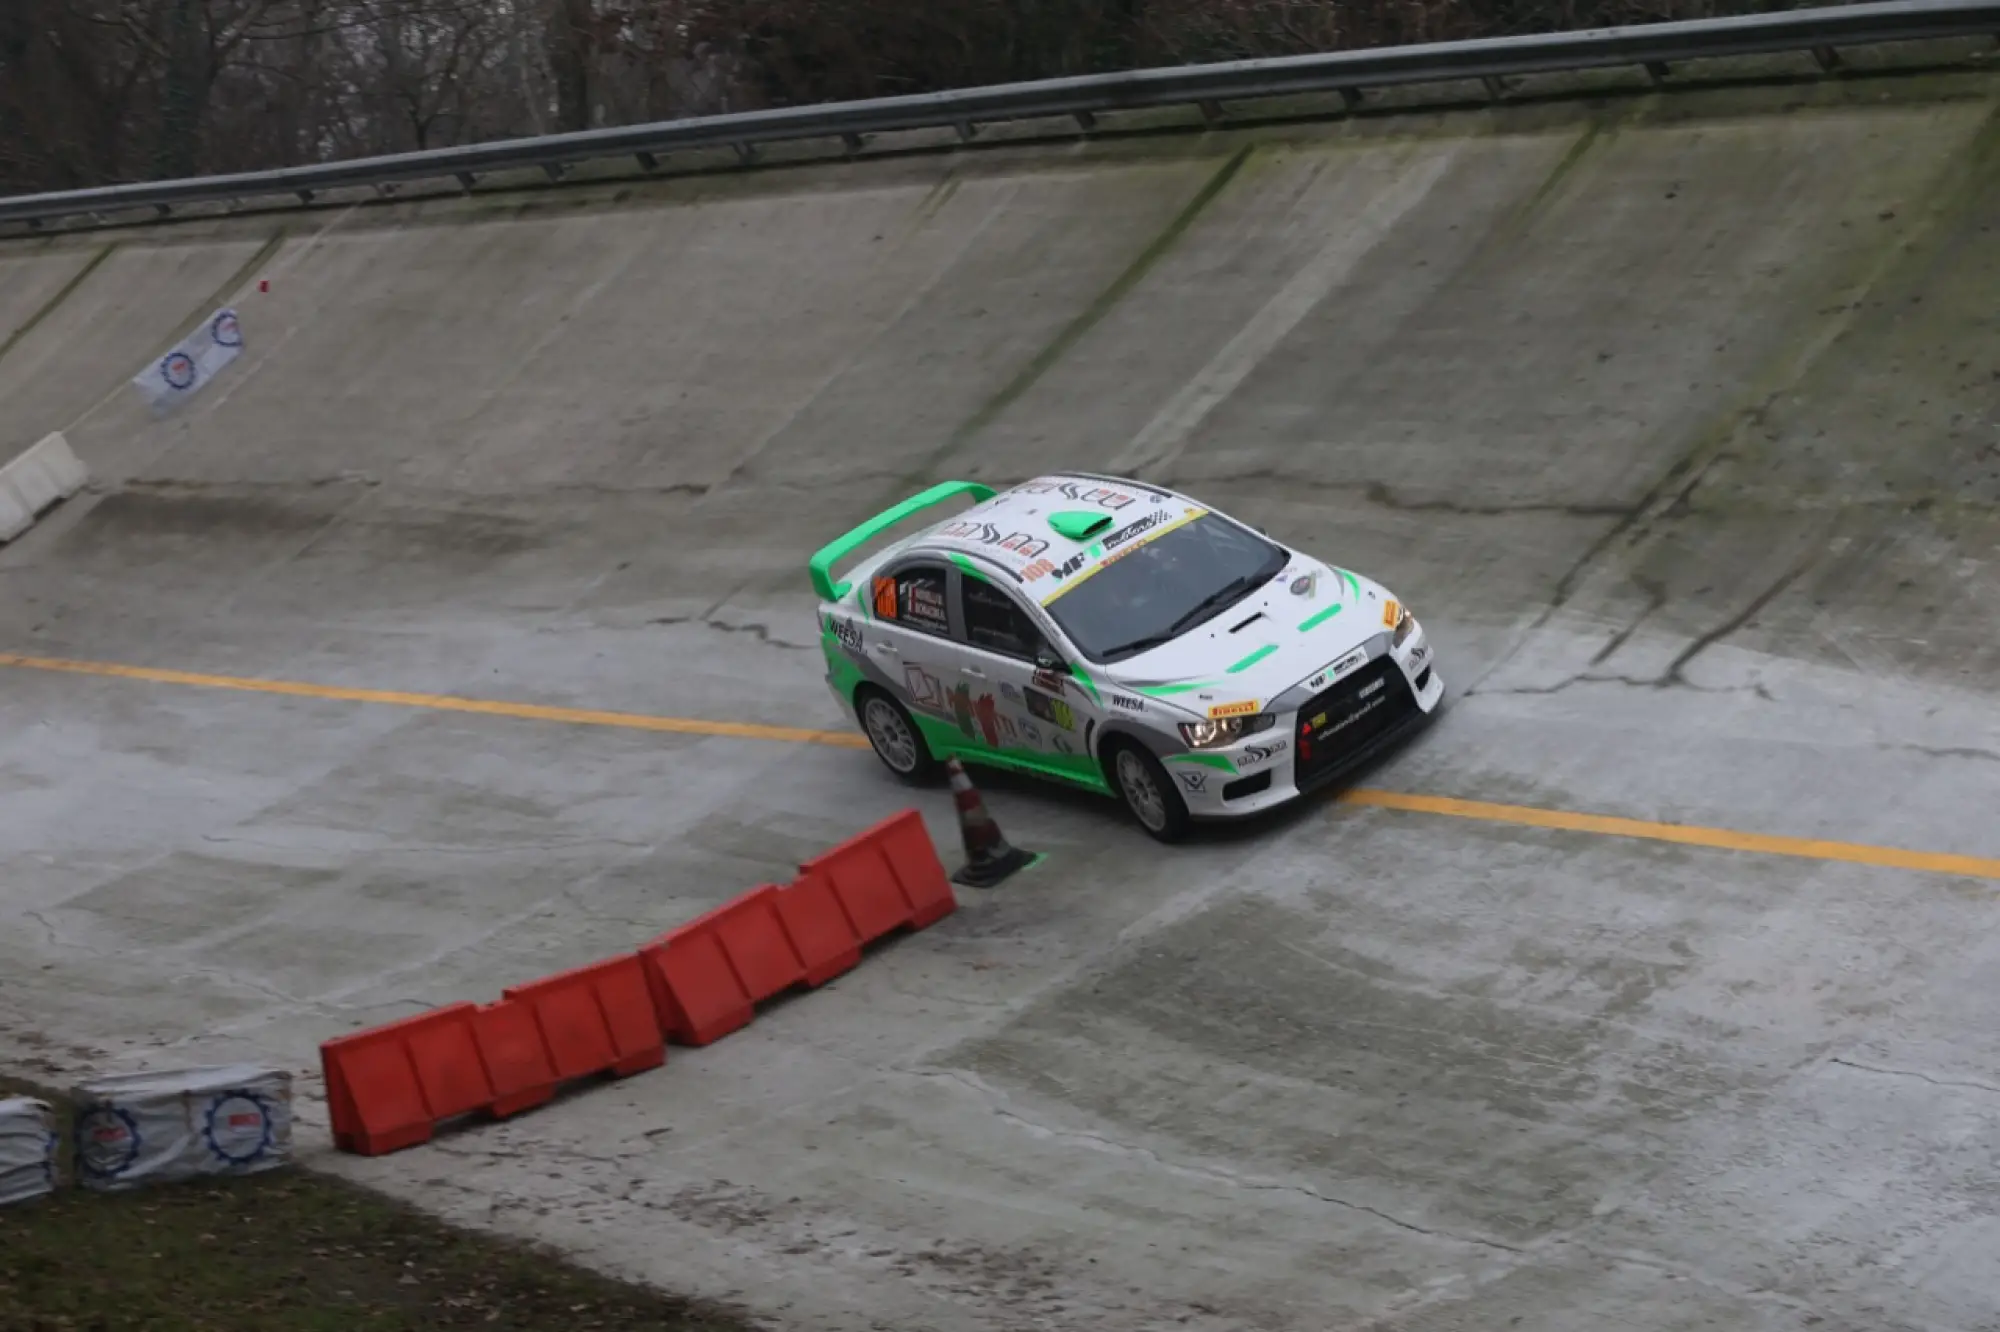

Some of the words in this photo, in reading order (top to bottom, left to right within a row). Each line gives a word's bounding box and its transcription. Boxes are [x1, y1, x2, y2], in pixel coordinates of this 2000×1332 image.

[831, 619, 863, 652] WEESA
[1112, 694, 1146, 712] WEESA
[1211, 702, 1255, 717] PIRELLI
